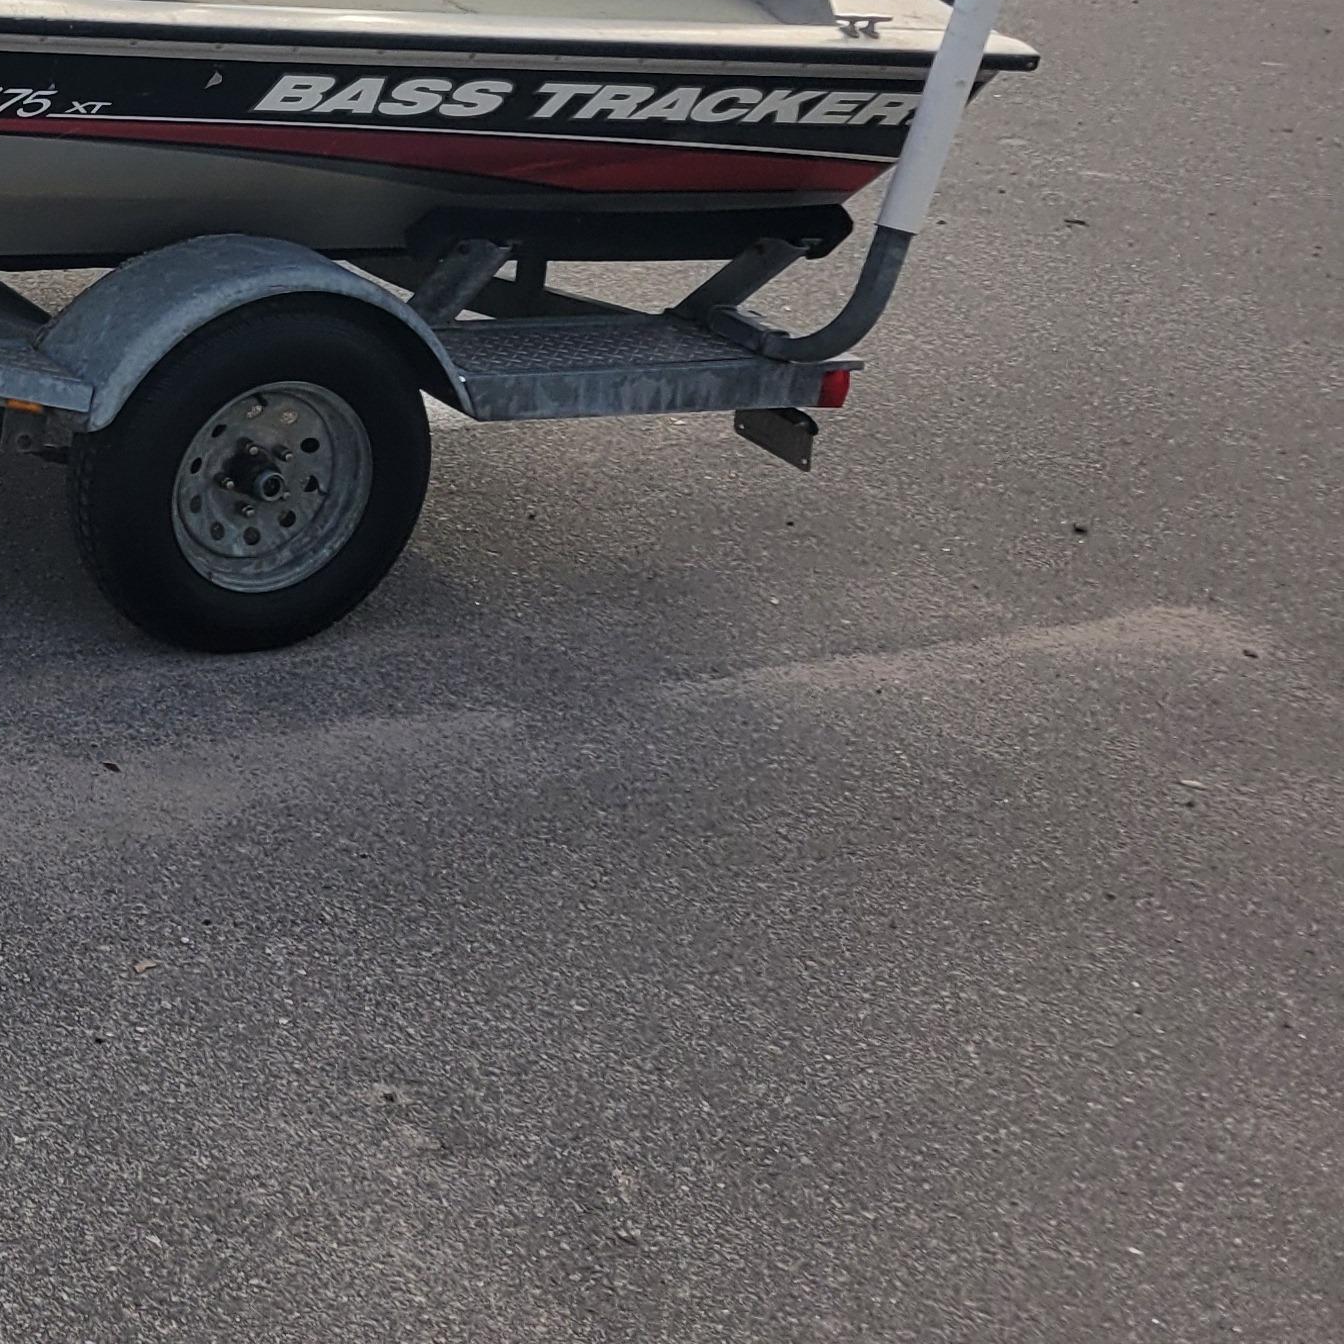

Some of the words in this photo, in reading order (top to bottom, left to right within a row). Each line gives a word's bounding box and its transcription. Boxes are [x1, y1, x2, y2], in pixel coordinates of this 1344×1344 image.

[63, 100, 113, 115] XT
[254, 74, 512, 118] BASS
[530, 81, 925, 126] TRACKER
